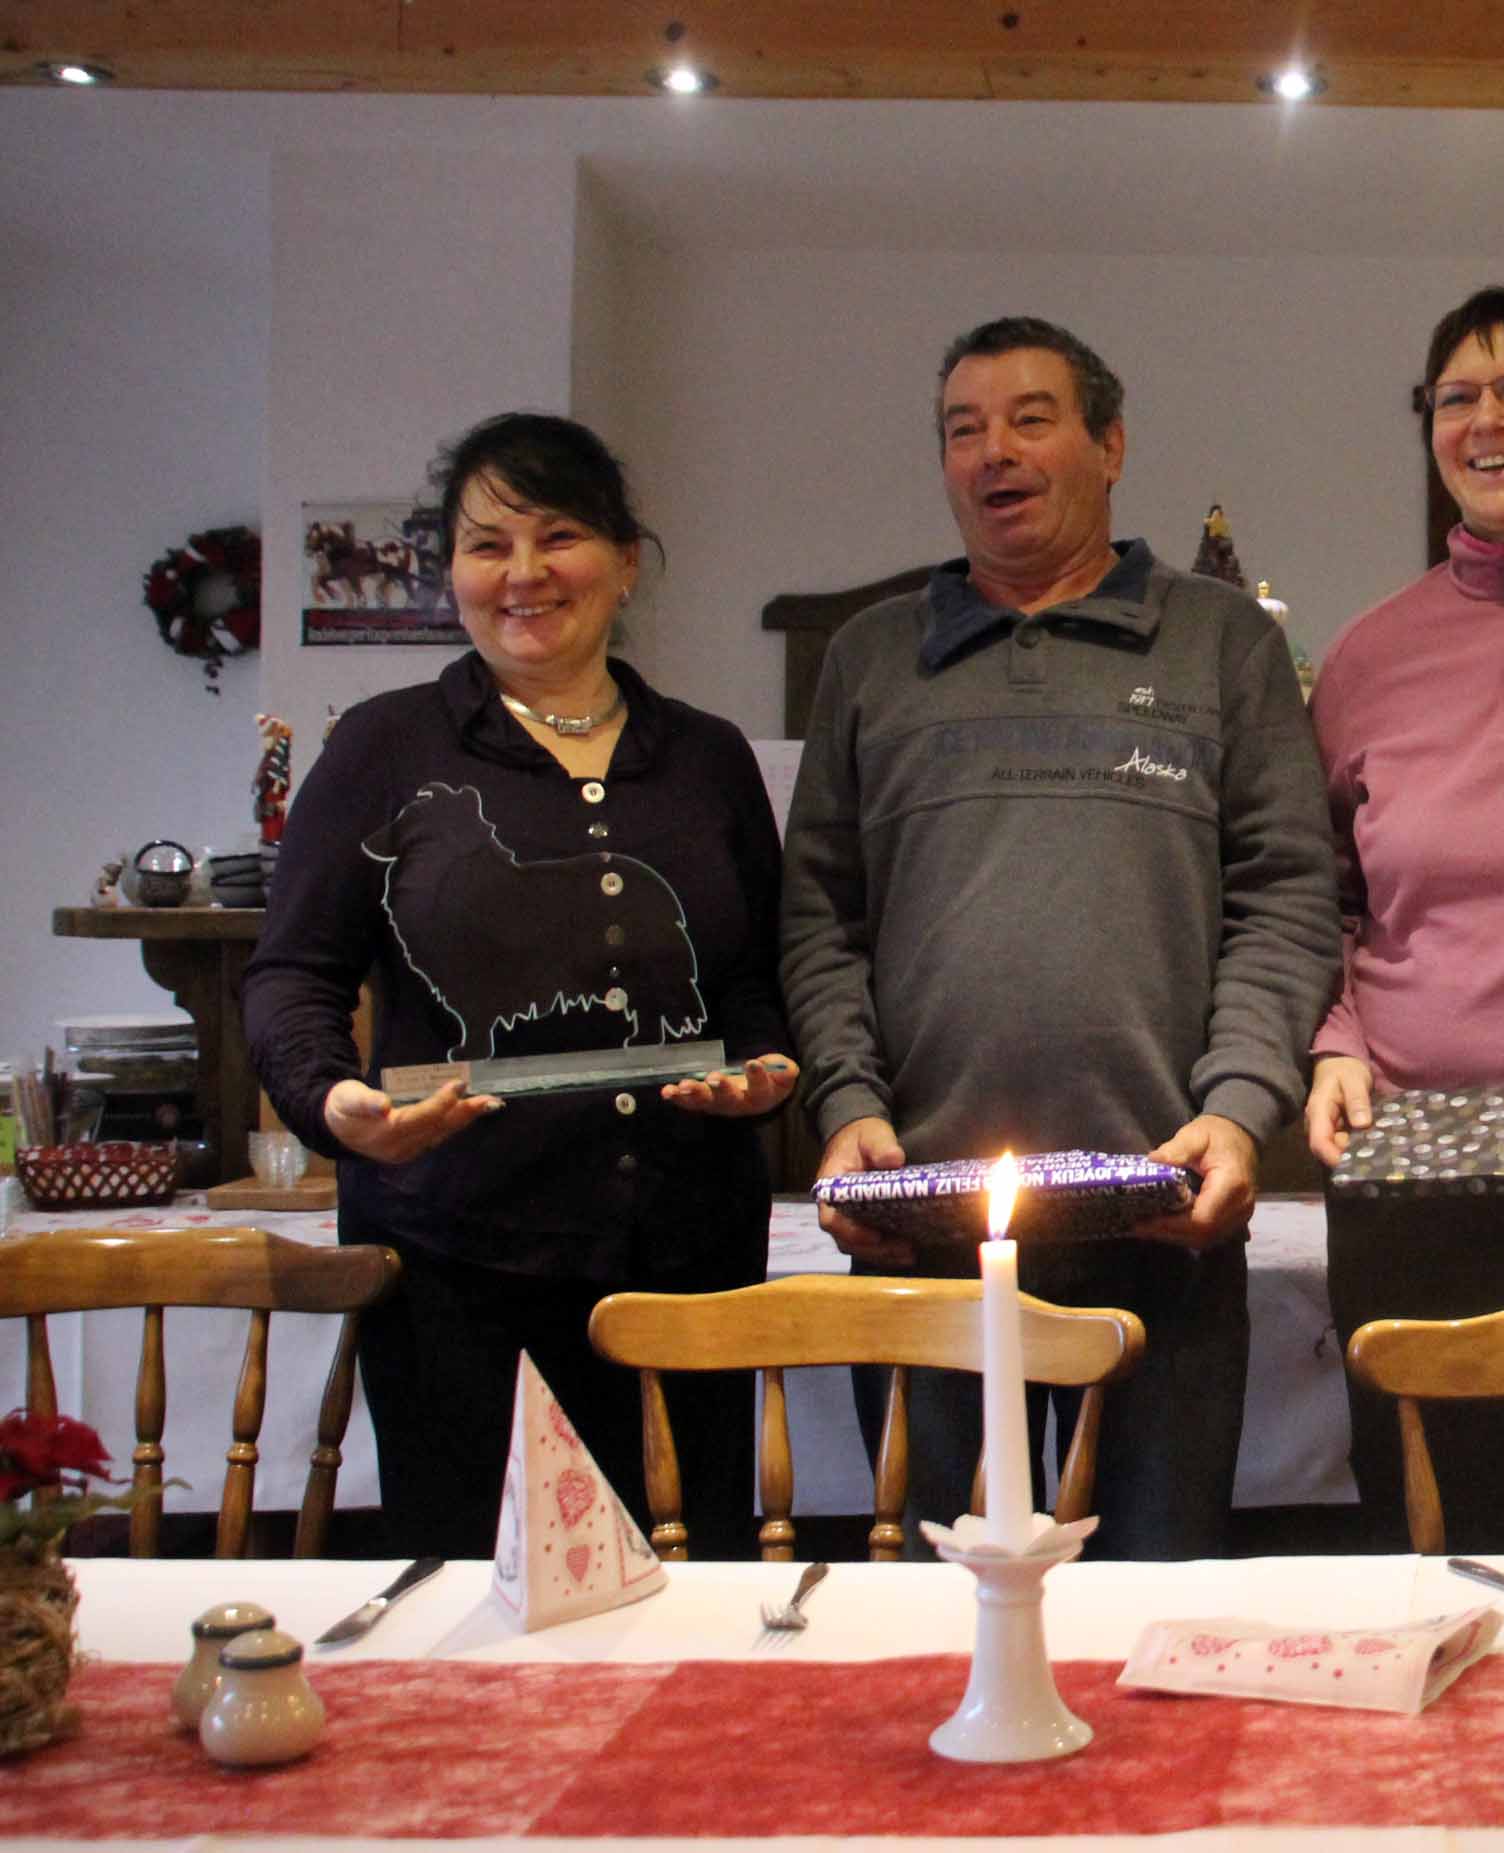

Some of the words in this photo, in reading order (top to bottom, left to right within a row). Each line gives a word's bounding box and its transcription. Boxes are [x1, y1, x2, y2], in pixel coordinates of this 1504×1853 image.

[1114, 747, 1188, 781] Alaska
[935, 1176, 980, 1196] FELIZ
[1051, 1168, 1116, 1186] JOYEUX
[852, 1180, 929, 1202] NAVIDAD
